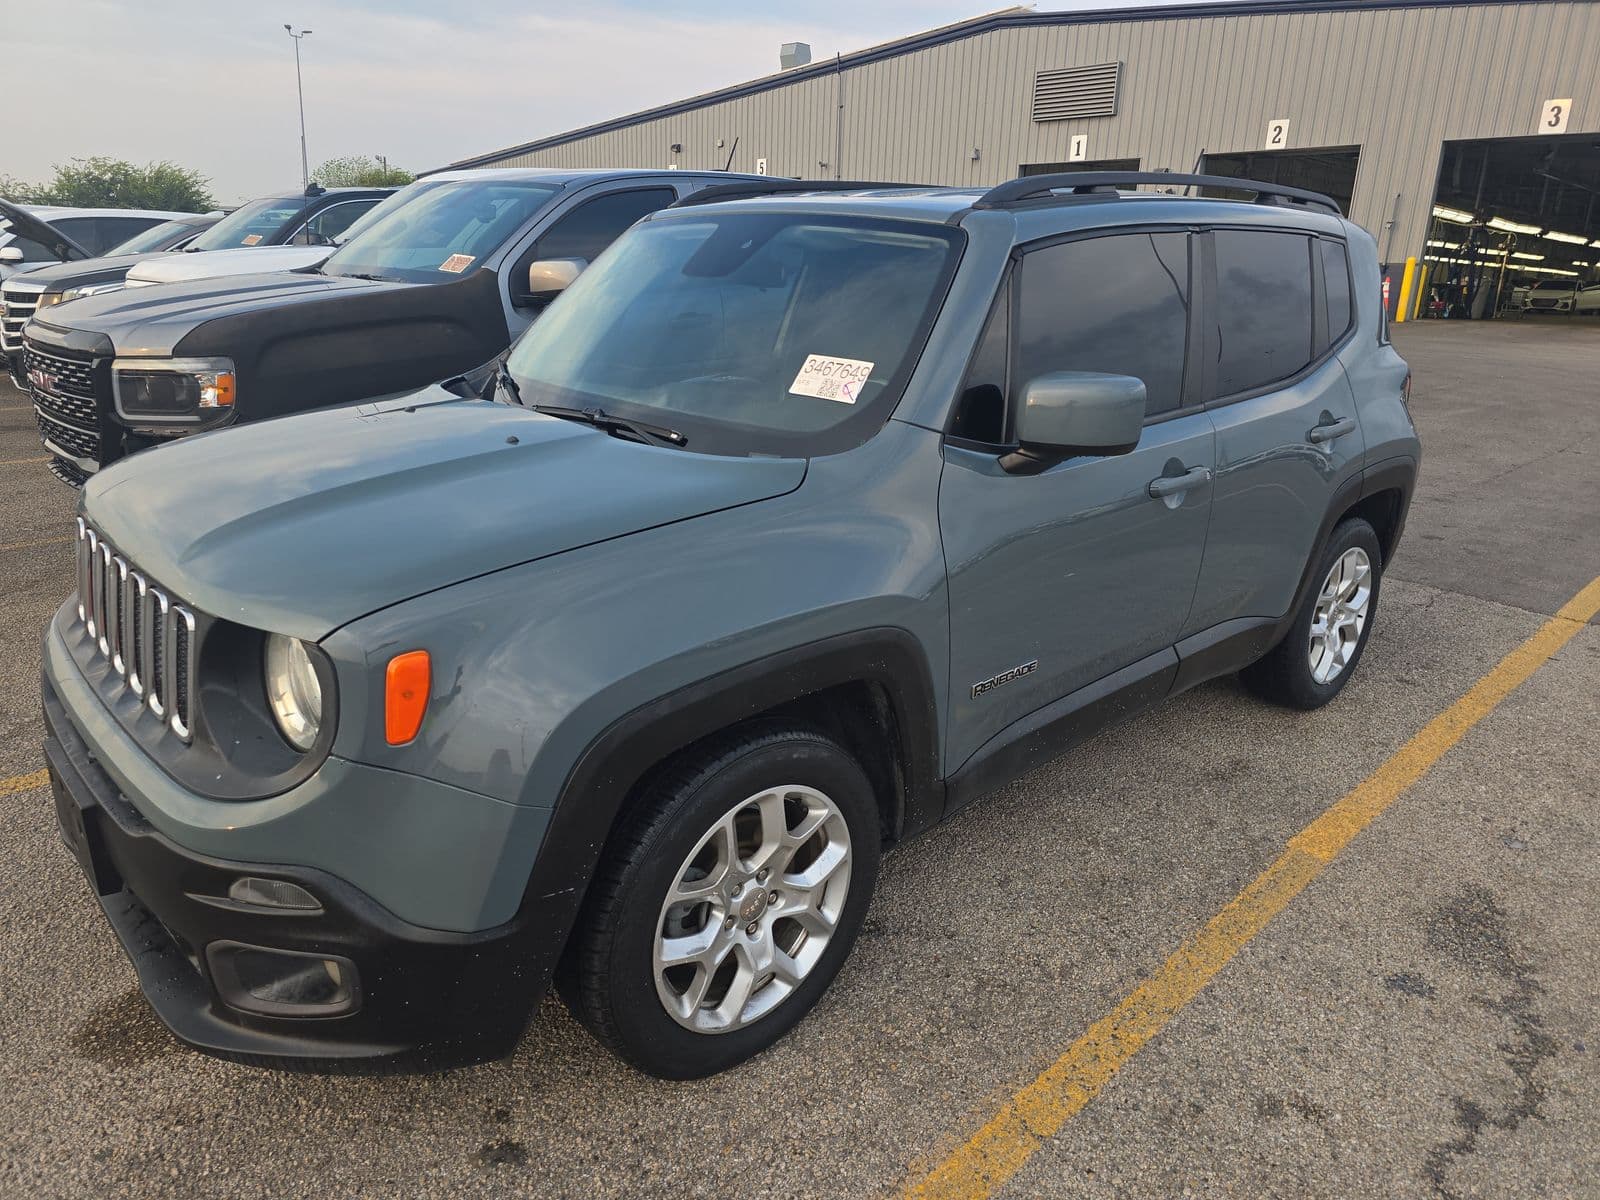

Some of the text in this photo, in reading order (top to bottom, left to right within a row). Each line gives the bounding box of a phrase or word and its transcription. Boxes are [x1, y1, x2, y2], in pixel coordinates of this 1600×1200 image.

[1547, 105, 1562, 128] 3
[1272, 125, 1283, 144] 2
[1074, 139, 1081, 157] 1
[759, 161, 765, 175] 5
[804, 358, 871, 382] 3467649
[970, 659, 1039, 700] RENEGADE
